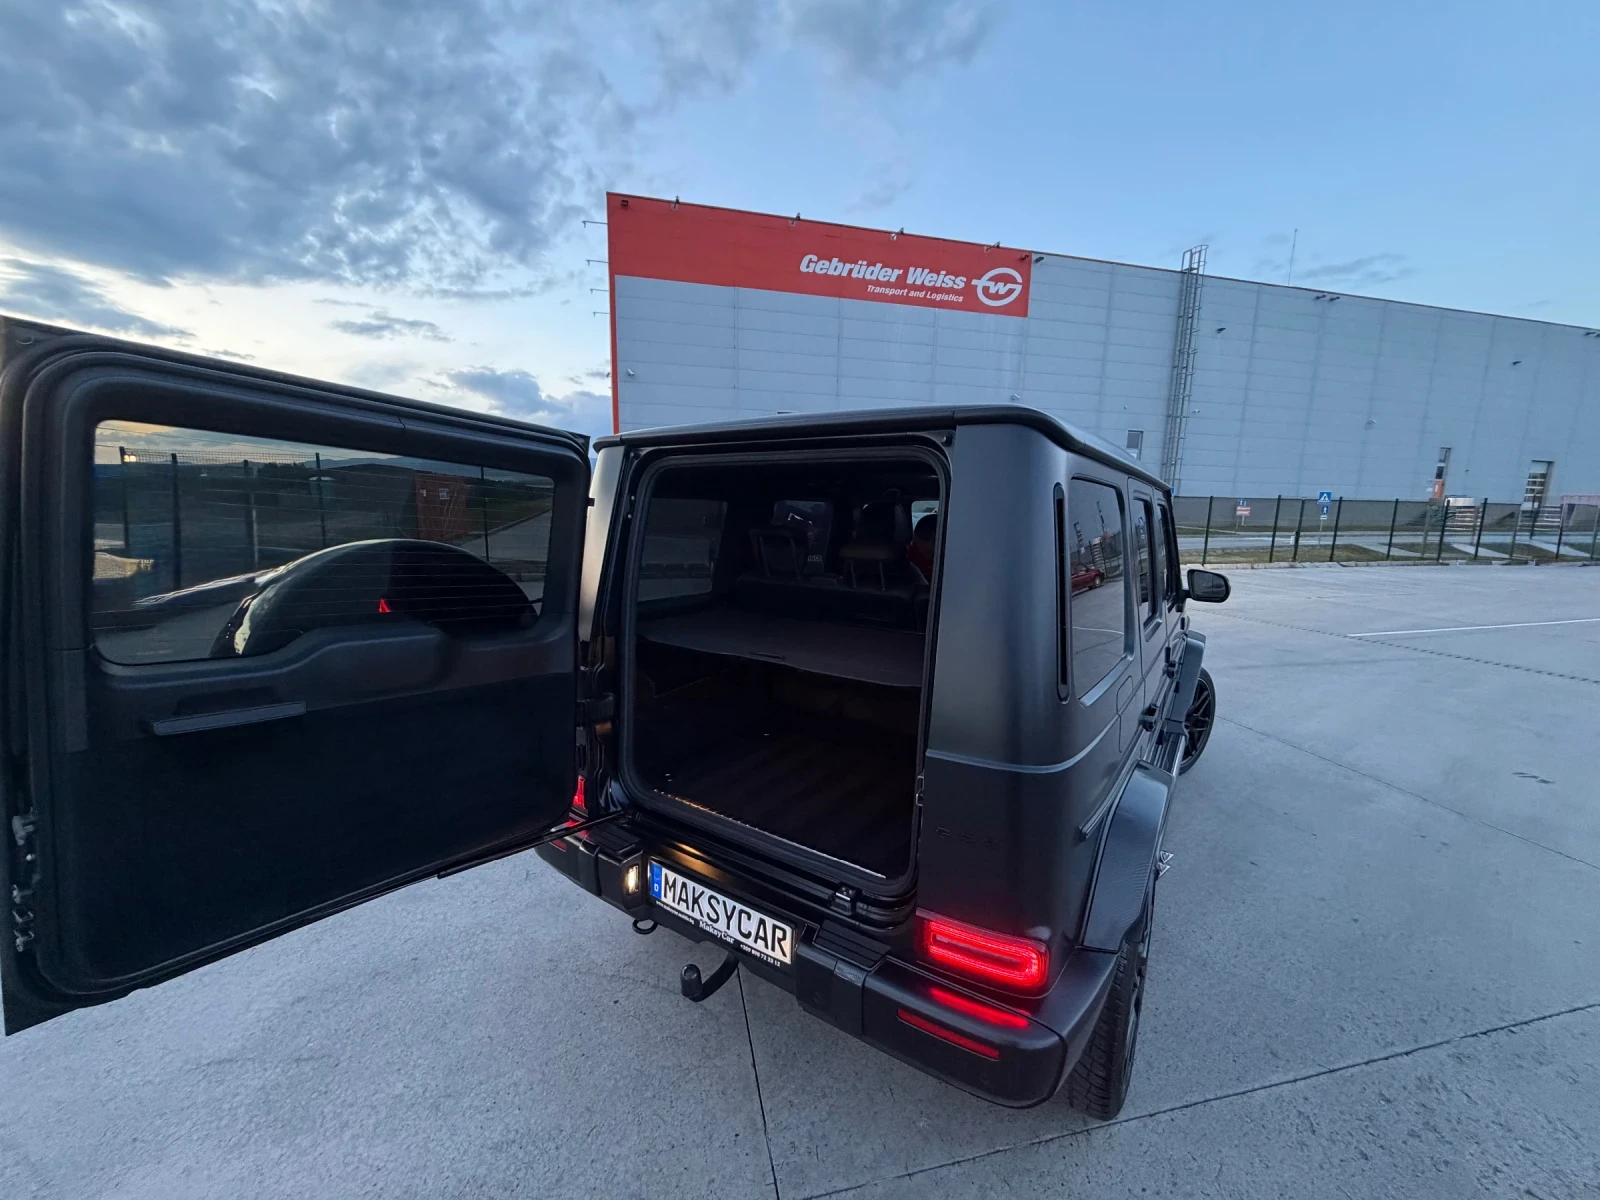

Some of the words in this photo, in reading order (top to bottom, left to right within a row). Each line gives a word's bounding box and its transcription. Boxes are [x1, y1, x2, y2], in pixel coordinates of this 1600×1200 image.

[799, 254, 904, 283] Gebrüder
[906, 266, 967, 289] Weiss
[866, 284, 908, 298] Transport
[908, 289, 926, 299] and
[926, 290, 964, 303] Logistics
[663, 872, 788, 958] MAKSYCAR
[699, 920, 735, 944] MaksyCar
